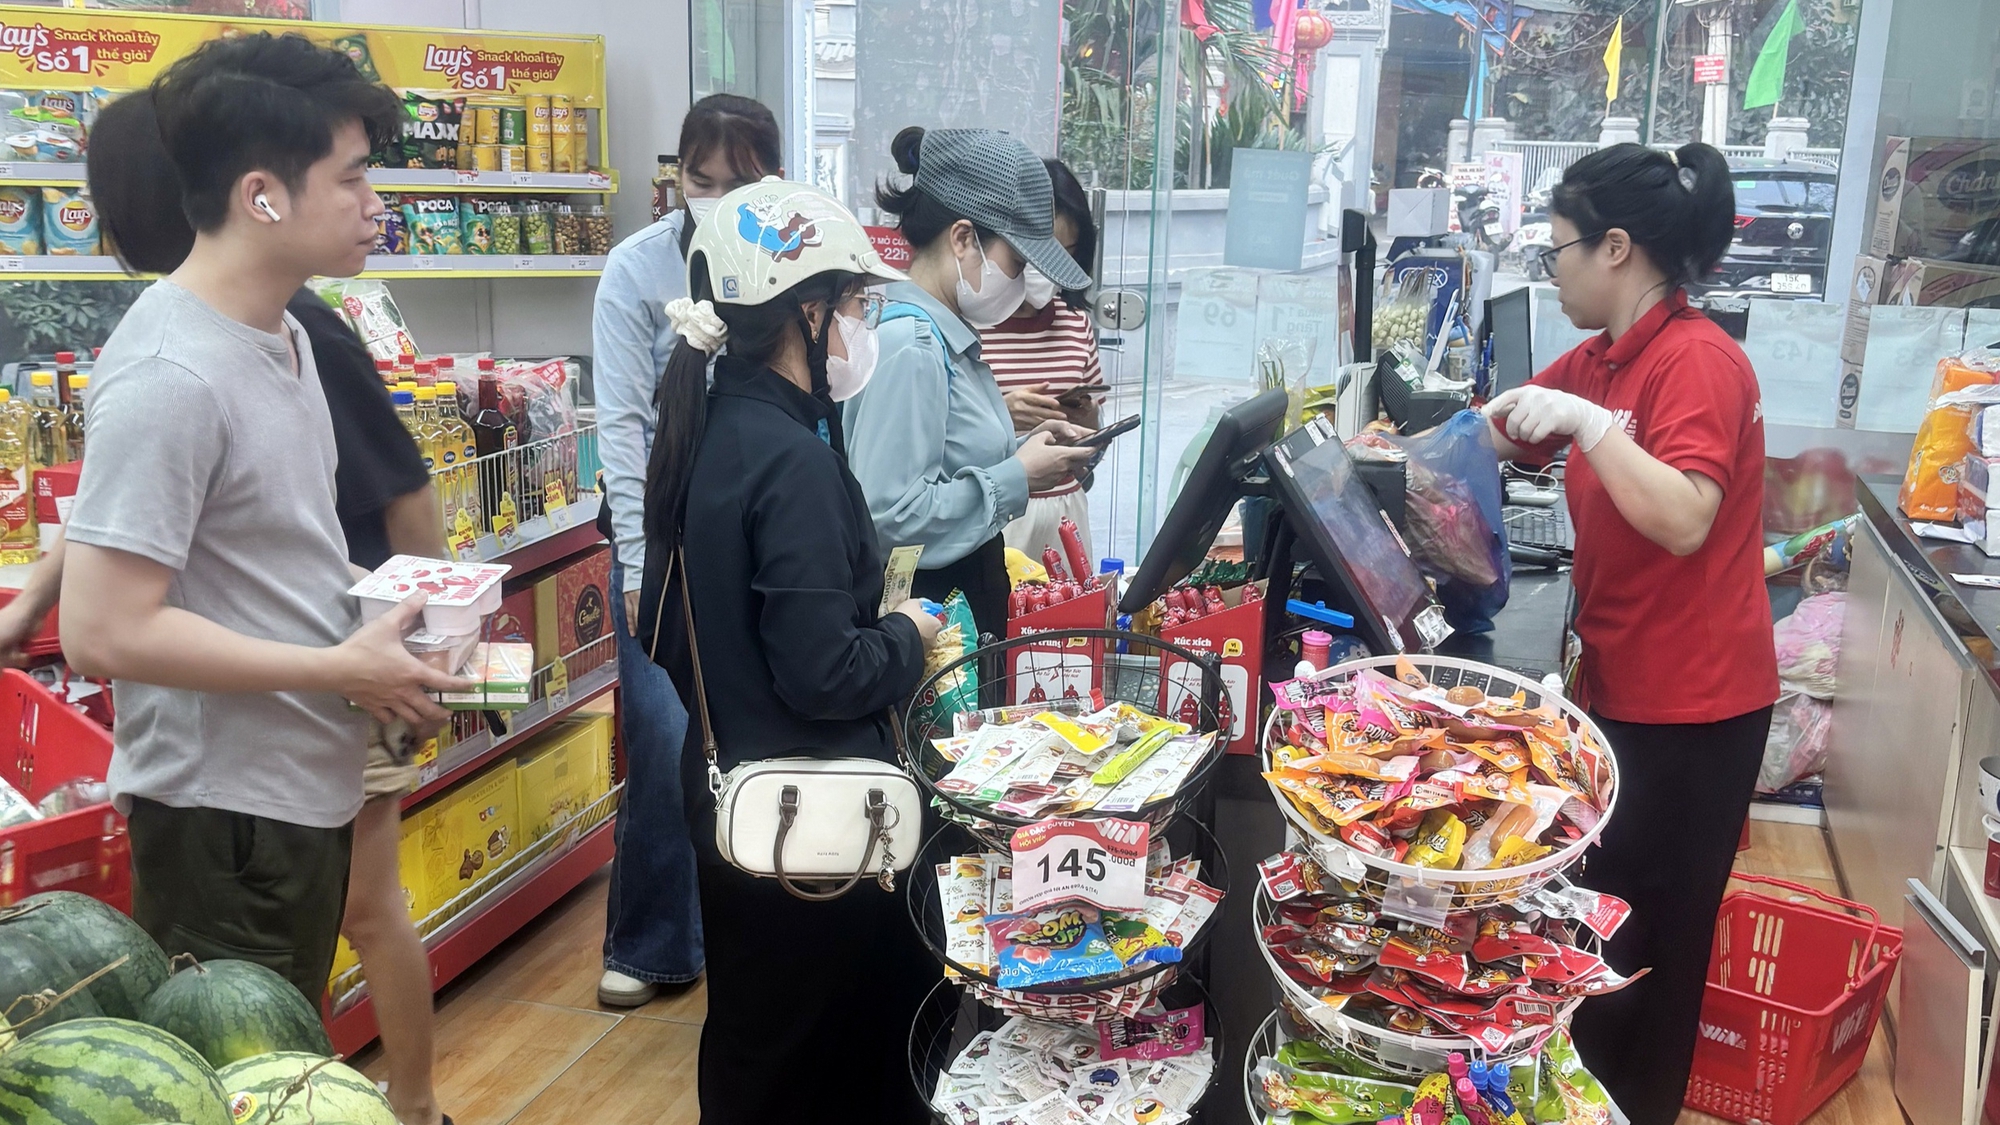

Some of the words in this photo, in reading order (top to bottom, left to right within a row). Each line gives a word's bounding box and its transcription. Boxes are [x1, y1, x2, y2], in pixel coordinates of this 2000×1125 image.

[54, 30, 97, 43] Snack
[37, 48, 70, 71] Số
[72, 45, 89, 72] 1
[426, 44, 473, 75] Lay's
[477, 49, 511, 62] Snack
[514, 51, 543, 64] khoai
[545, 54, 563, 66] tây
[461, 67, 489, 89] Số
[490, 65, 505, 89] 1
[511, 67, 530, 79] thế
[533, 124, 549, 133] STA
[417, 199, 454, 212] POCA
[478, 199, 509, 214] POCA
[1173, 636, 1191, 646] Xúc
[1192, 637, 1212, 647] xích
[1037, 848, 1107, 883] 145
